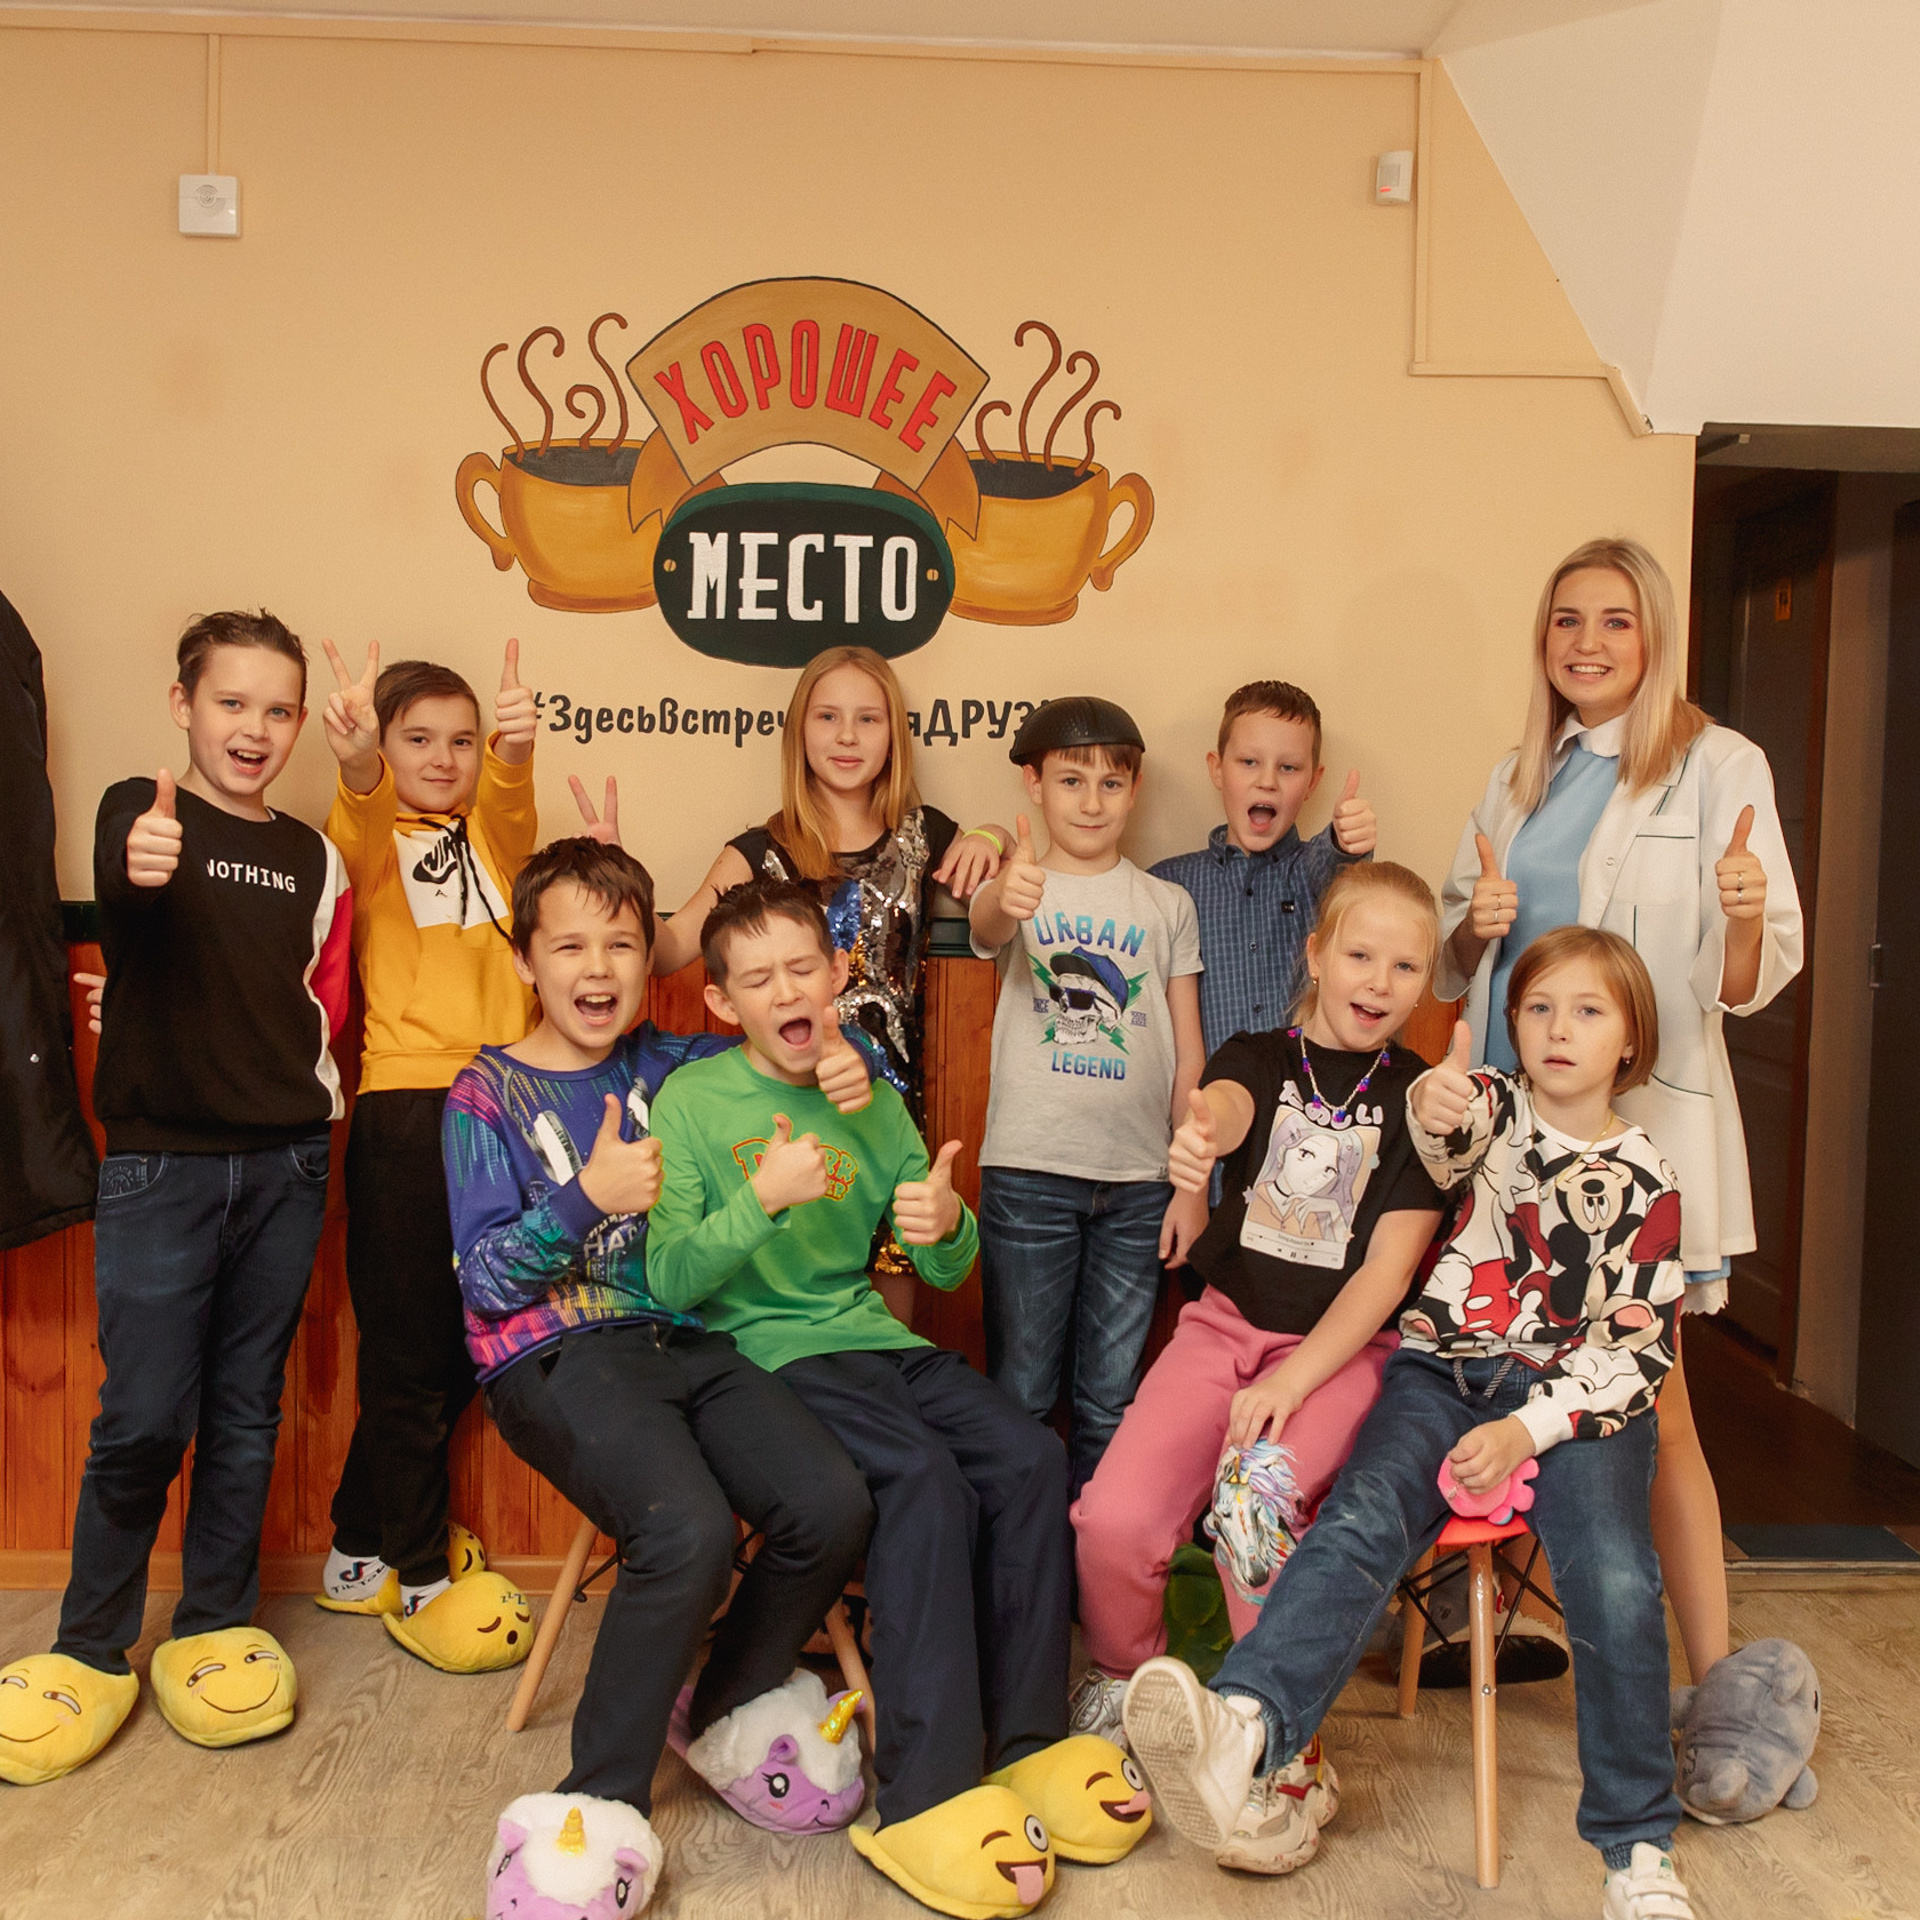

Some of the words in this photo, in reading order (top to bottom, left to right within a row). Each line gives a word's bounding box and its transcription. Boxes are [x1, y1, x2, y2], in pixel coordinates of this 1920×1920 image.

[653, 319, 958, 453] ХОРОШЕЕ
[687, 531, 919, 624] МЕСТО
[206, 858, 296, 893] NOTHING
[1033, 911, 1146, 958] URBAN
[1051, 1050, 1126, 1081] LEGEND
